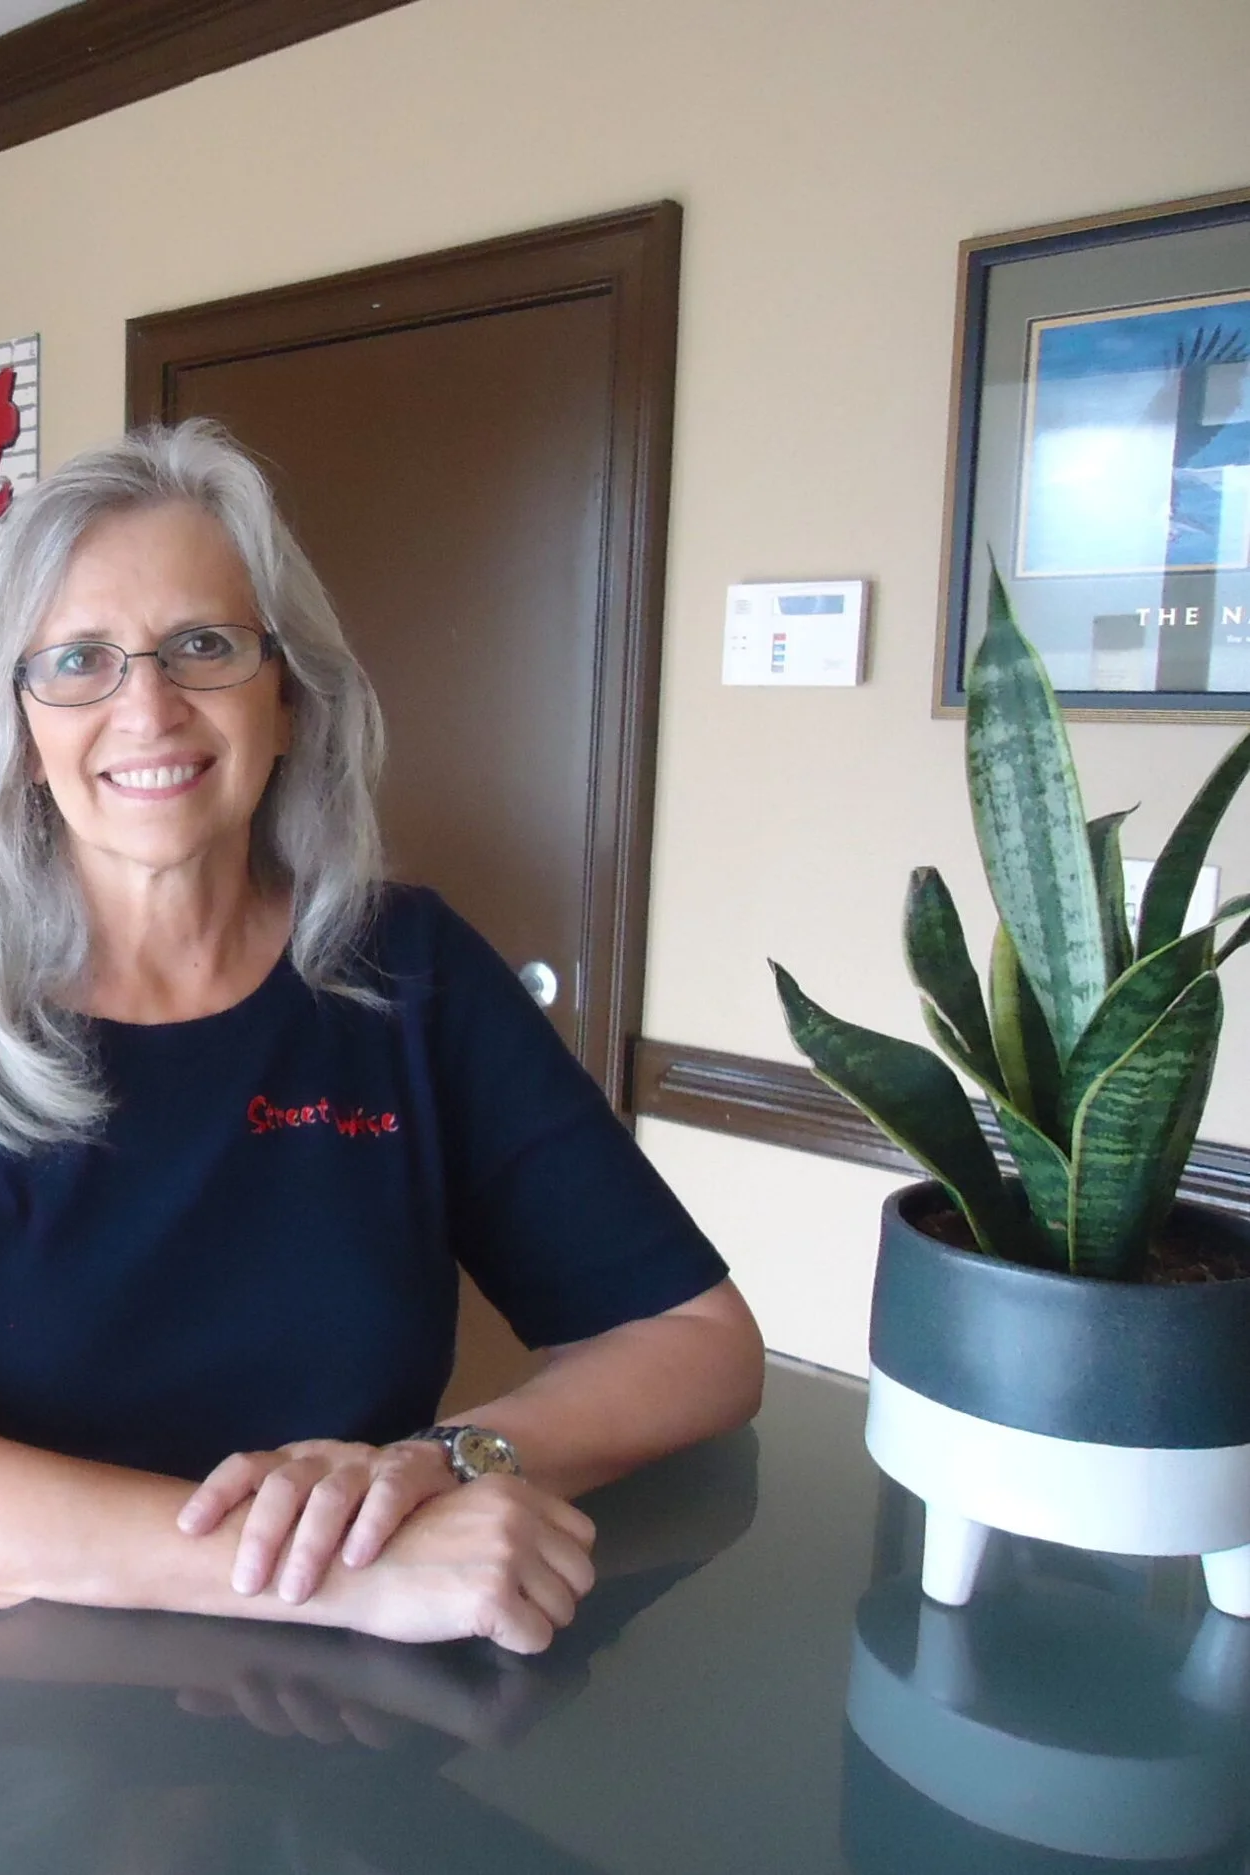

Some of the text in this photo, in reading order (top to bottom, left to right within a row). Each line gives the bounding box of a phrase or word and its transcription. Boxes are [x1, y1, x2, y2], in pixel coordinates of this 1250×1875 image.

[1135, 606, 1250, 626] THE N
[247, 1095, 330, 1134] Street
